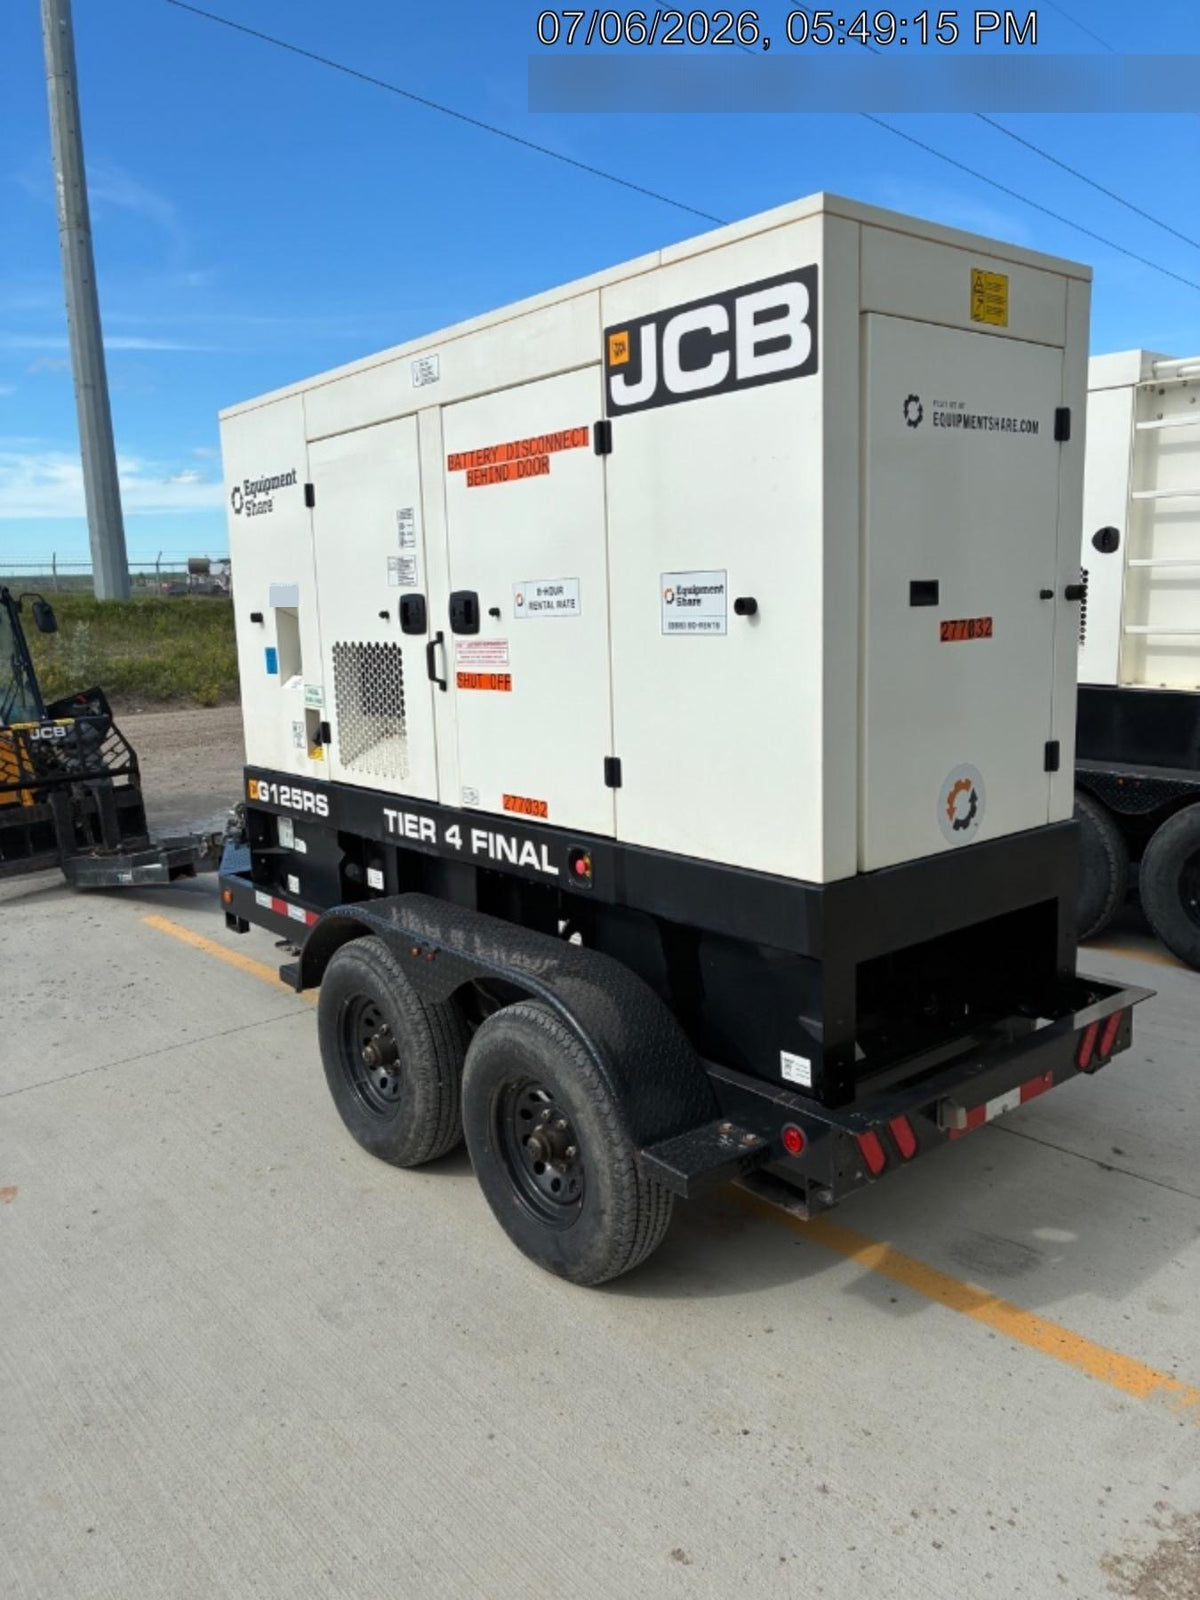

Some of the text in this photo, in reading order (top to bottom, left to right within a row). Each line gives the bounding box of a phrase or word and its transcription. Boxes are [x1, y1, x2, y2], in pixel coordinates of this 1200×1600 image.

[610, 281, 812, 406] JCB
[932, 411, 1039, 435] EQUIPMENTSHARE.COM
[448, 426, 589, 471] BATTERY DISCONNECT
[243, 467, 297, 498] Equipment
[467, 455, 550, 487] BEHIND DOOR
[245, 499, 273, 517] Share
[456, 671, 512, 692] SHUT OFF
[30, 726, 66, 740] JCB
[258, 780, 329, 817] G125RS
[383, 807, 560, 875] TIER 4 FINAL
